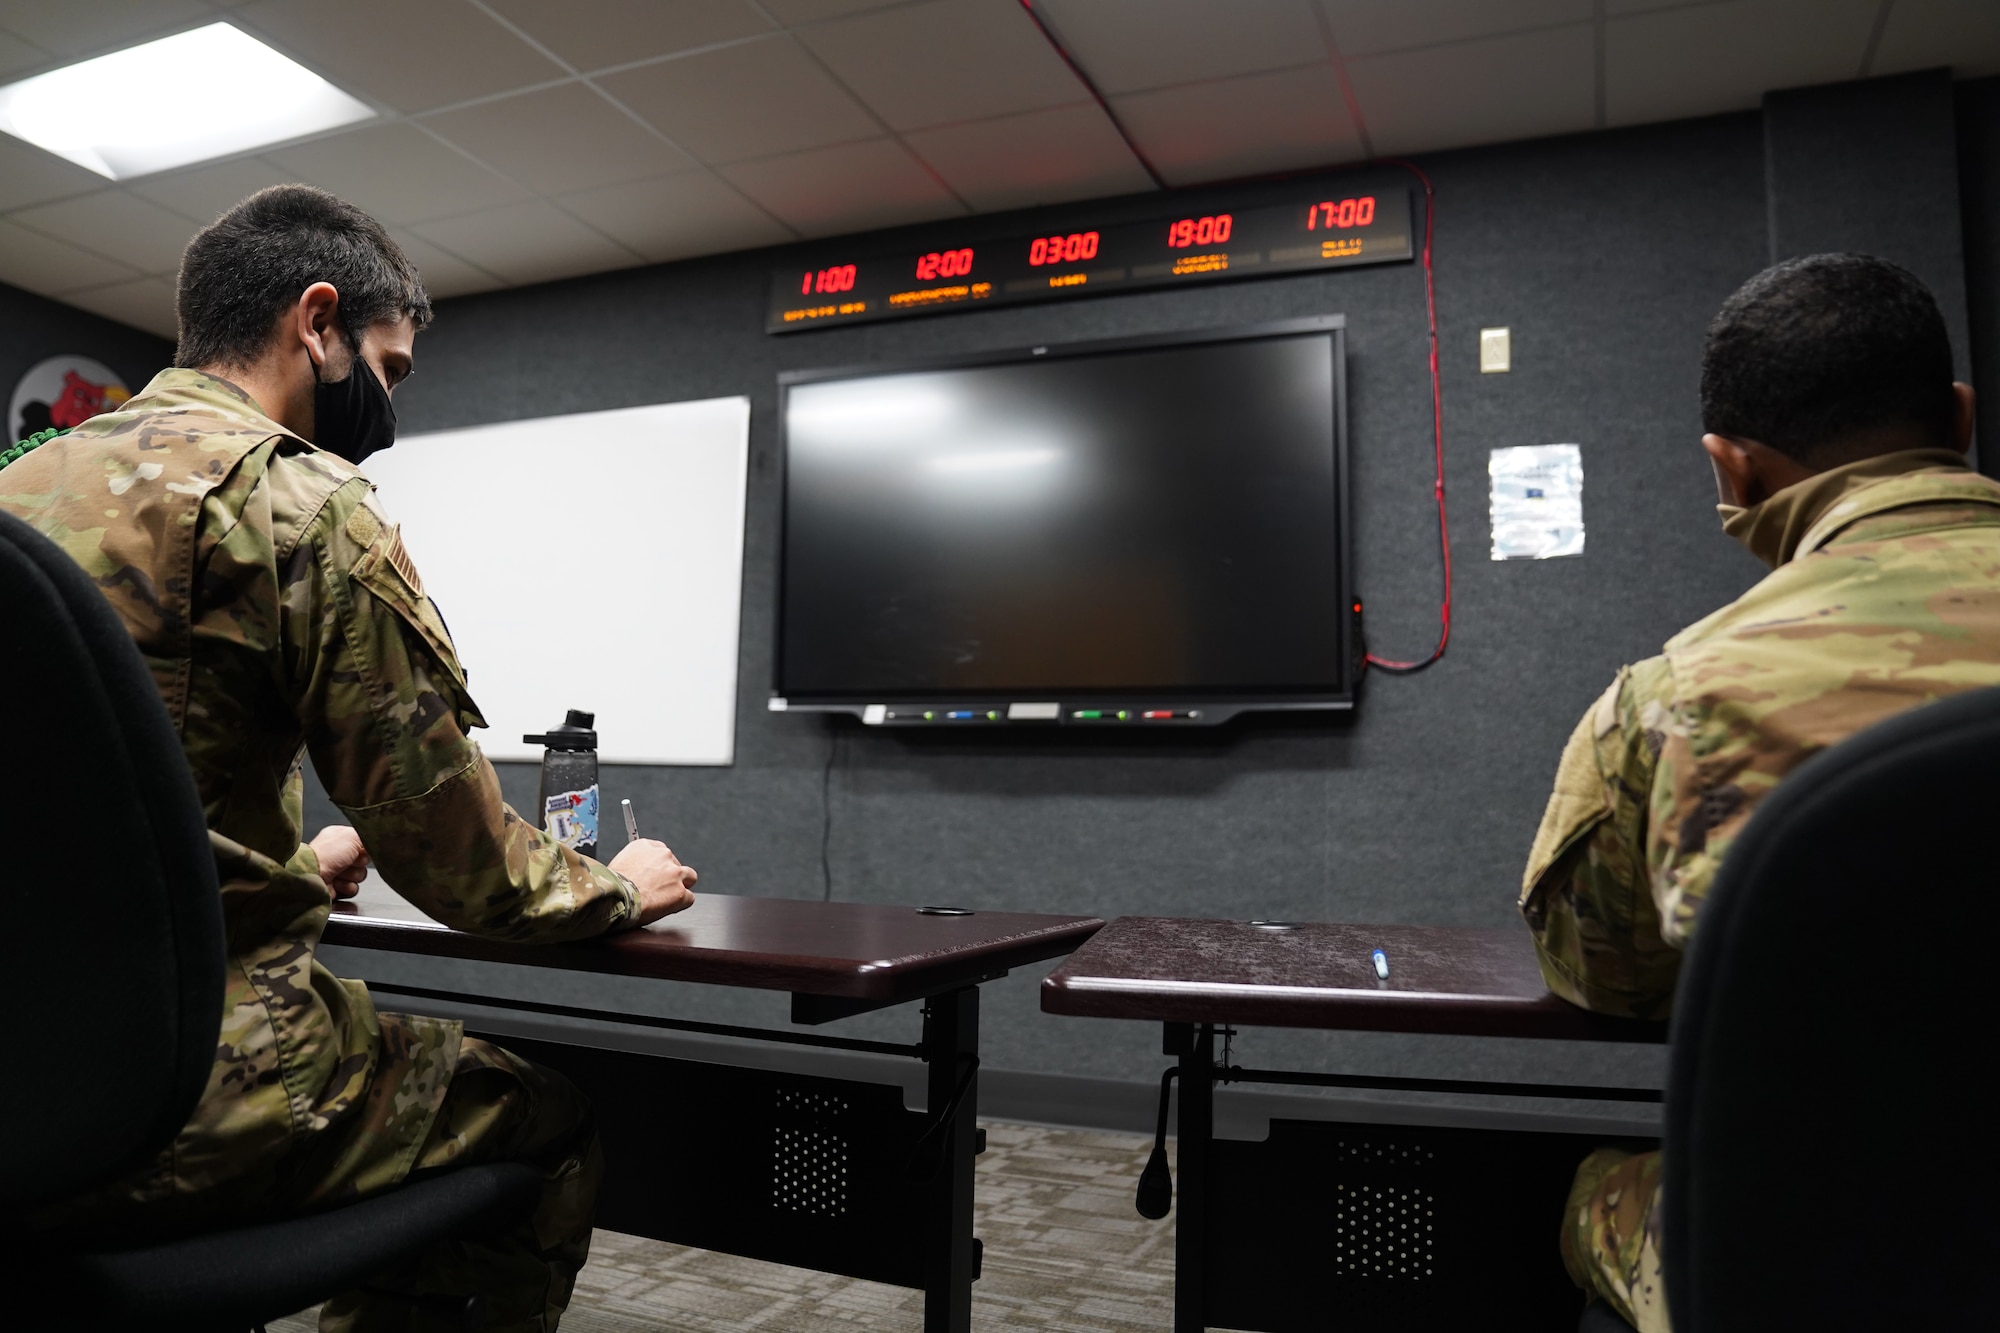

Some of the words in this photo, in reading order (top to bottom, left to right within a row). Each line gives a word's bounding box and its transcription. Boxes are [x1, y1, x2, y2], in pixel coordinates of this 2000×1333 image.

[1307, 196, 1376, 231] 17:00
[1167, 214, 1233, 248] 19:00
[915, 247, 975, 281] 12:00
[1029, 231, 1100, 267] 03:00
[801, 264, 857, 295] 11:00
